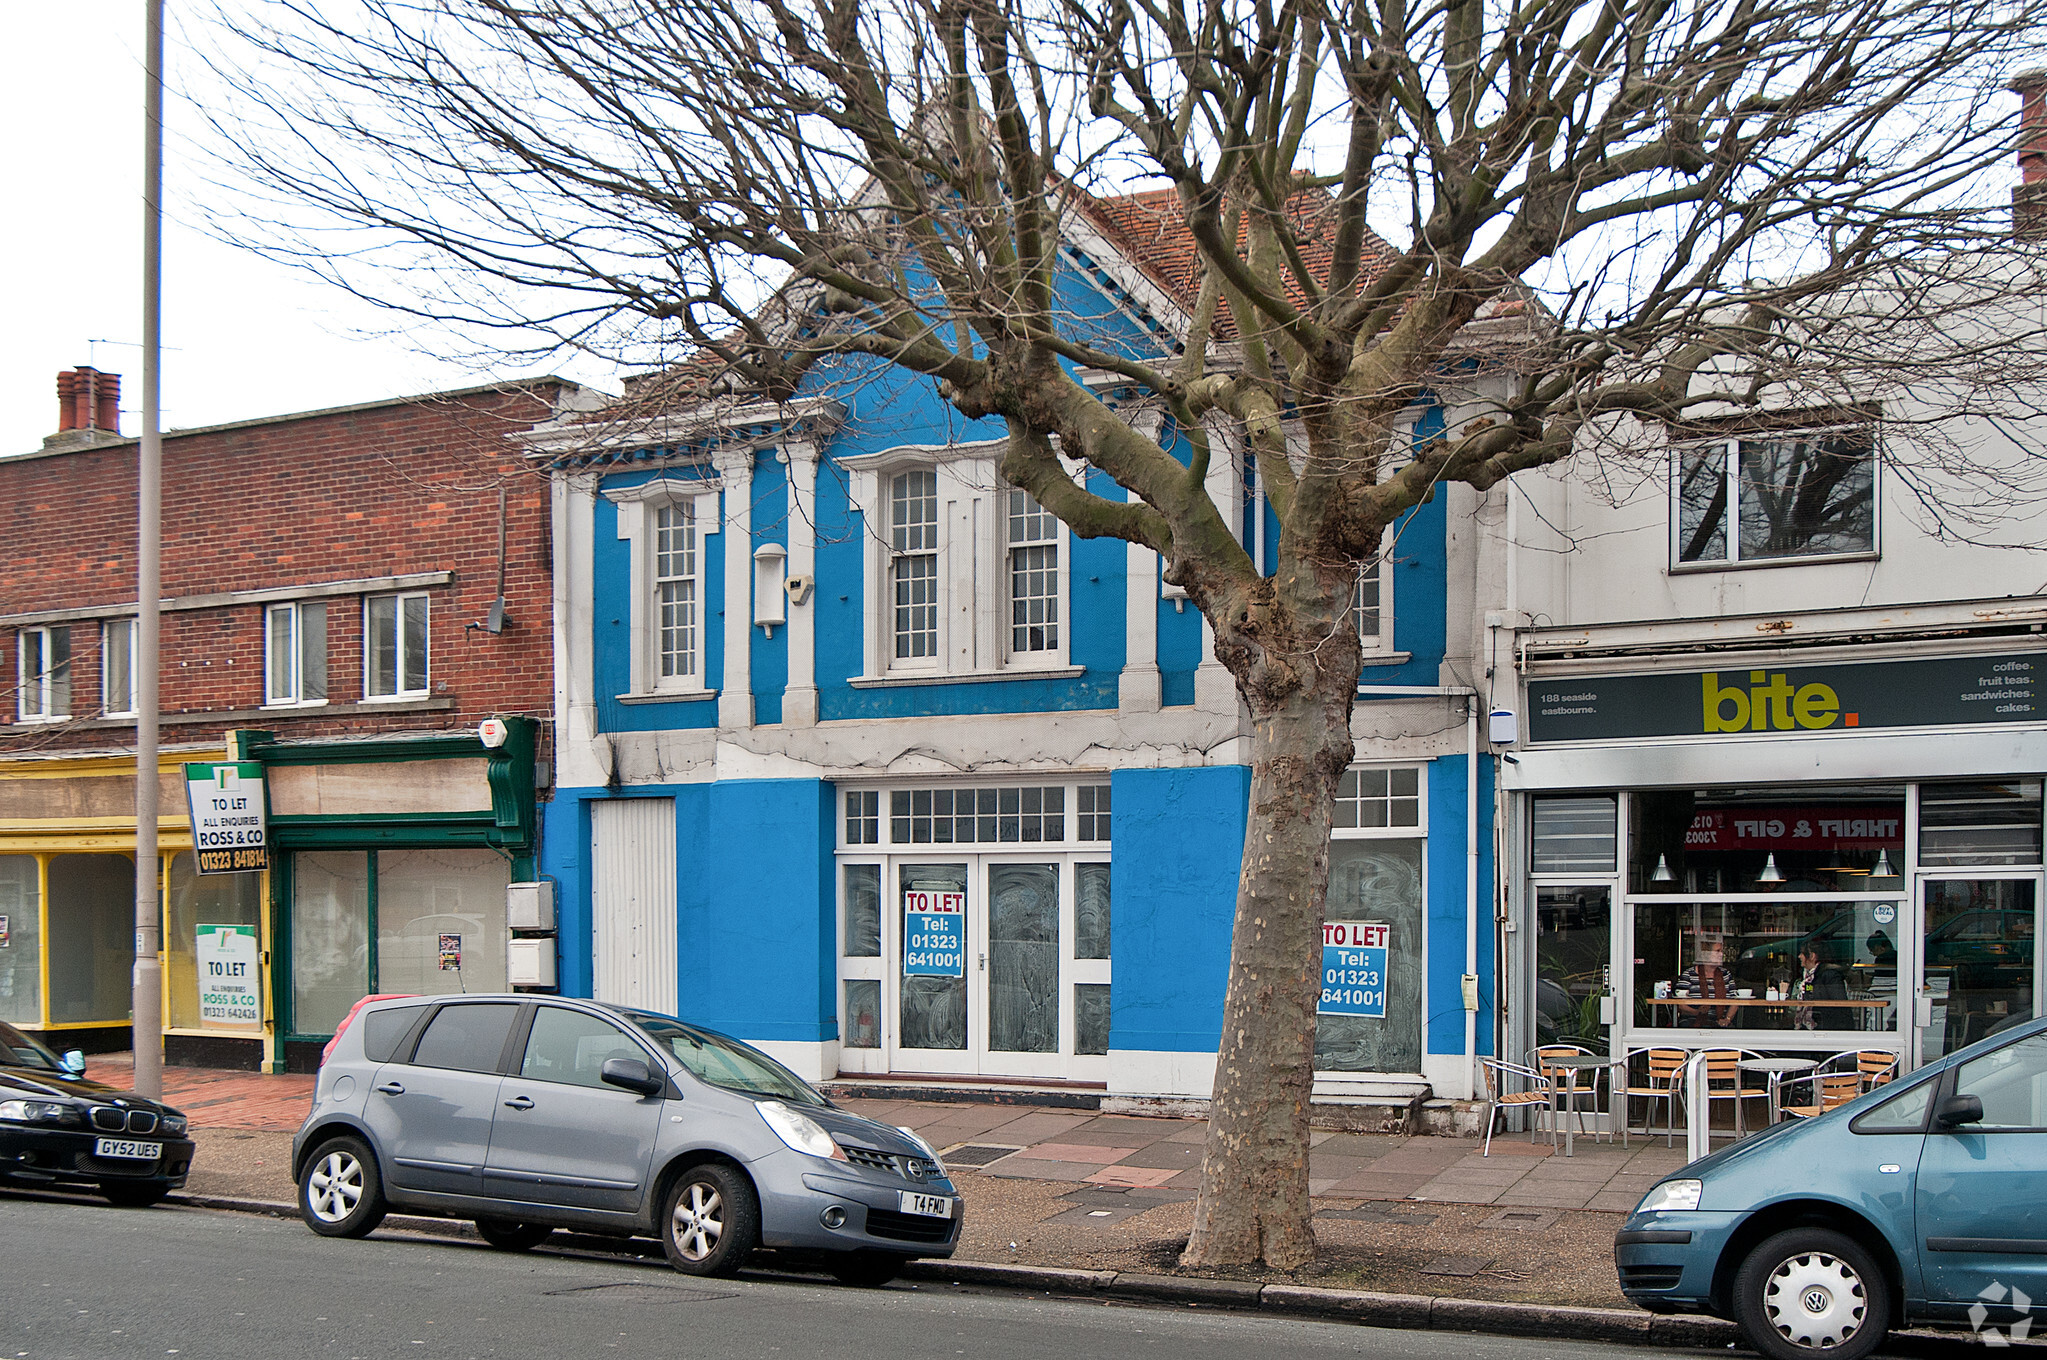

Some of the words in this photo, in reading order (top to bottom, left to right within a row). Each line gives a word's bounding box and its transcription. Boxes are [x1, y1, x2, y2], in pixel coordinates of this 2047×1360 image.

[1993, 661, 2034, 671] coffee.
[1978, 676, 2003, 686] fruit
[2004, 676, 2035, 685] teas.
[1541, 694, 1559, 703] 188
[1561, 692, 1597, 702] seaside
[1702, 670, 1859, 733] bite.
[1961, 689, 2035, 701] sandwiches.
[1541, 706, 1597, 716] eastbourne.
[1995, 703, 2036, 713] cakes.
[212, 798, 228, 811] TO
[231, 797, 247, 810] LET
[203, 818, 219, 828] ALL
[221, 816, 259, 827] ENQUIRIES
[199, 831, 234, 846] ROSS
[236, 831, 246, 844] &
[247, 830, 263, 844] CO
[200, 851, 232, 871] 01323
[234, 849, 265, 869] 841814
[907, 893, 929, 912] TO
[933, 893, 963, 913] LET
[921, 917, 949, 931] Tel:
[912, 934, 957, 949] 01323
[1322, 924, 1347, 945] TO
[1352, 925, 1388, 947] LET
[907, 952, 961, 968] 641001
[1338, 950, 1370, 967] Tel:
[208, 961, 223, 976] TO
[226, 962, 246, 977] LET
[1326, 969, 1379, 986] 01323
[203, 993, 228, 1005] ROSS
[230, 995, 238, 1005] &
[240, 995, 255, 1006] CO
[1321, 988, 1383, 1006] 641001
[204, 1007, 225, 1018] 01323
[228, 1008, 257, 1020] 642426
[102, 1141, 136, 1156] GY52
[137, 1143, 159, 1157] UES
[914, 1194, 926, 1212] T4
